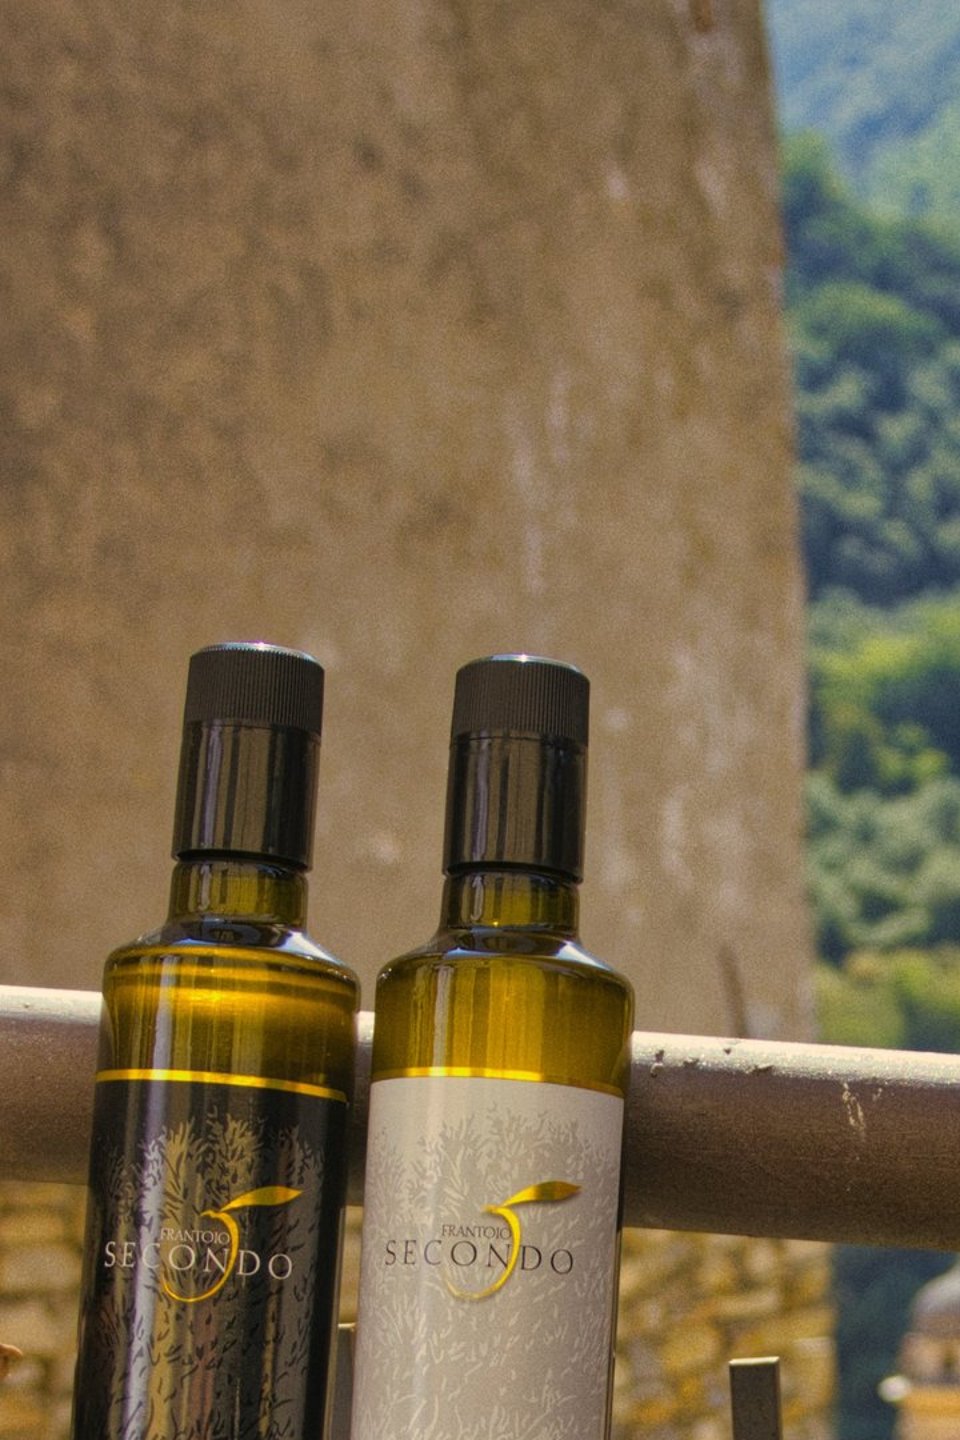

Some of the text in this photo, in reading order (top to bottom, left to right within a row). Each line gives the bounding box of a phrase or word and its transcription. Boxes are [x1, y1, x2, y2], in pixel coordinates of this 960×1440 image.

[160, 1226, 231, 1246] FRANTOIO
[441, 1224, 512, 1241] FRANTOIO
[104, 1241, 293, 1281] SECONDO
[385, 1239, 574, 1275] SECONDO
